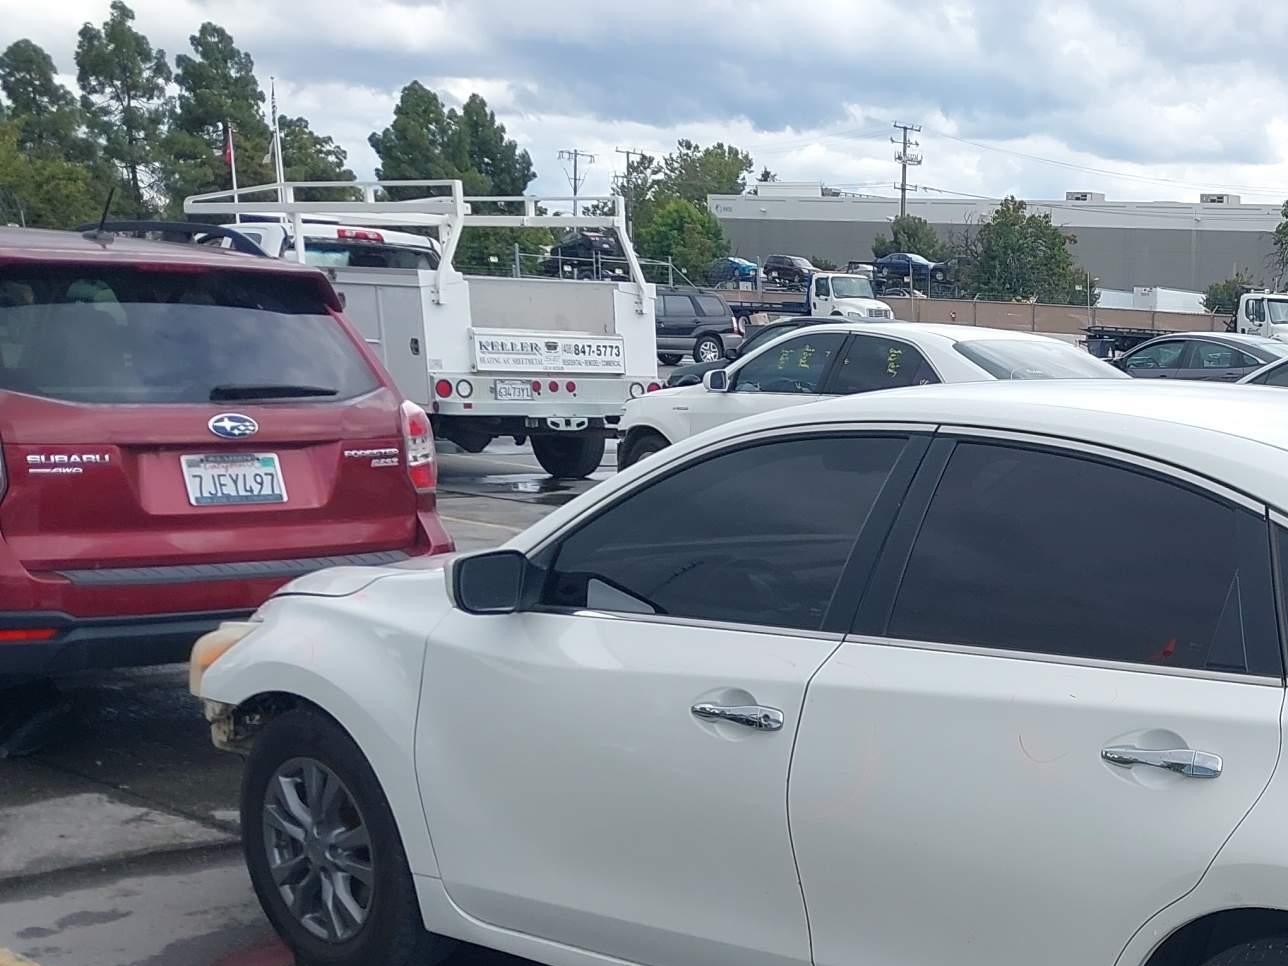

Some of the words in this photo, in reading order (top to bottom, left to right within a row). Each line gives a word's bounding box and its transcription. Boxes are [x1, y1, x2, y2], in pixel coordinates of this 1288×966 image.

[478, 340, 543, 356] KELLER
[573, 343, 621, 357] 847-5773
[26, 454, 110, 464] SUBARU
[192, 472, 276, 496] 7JEY497
